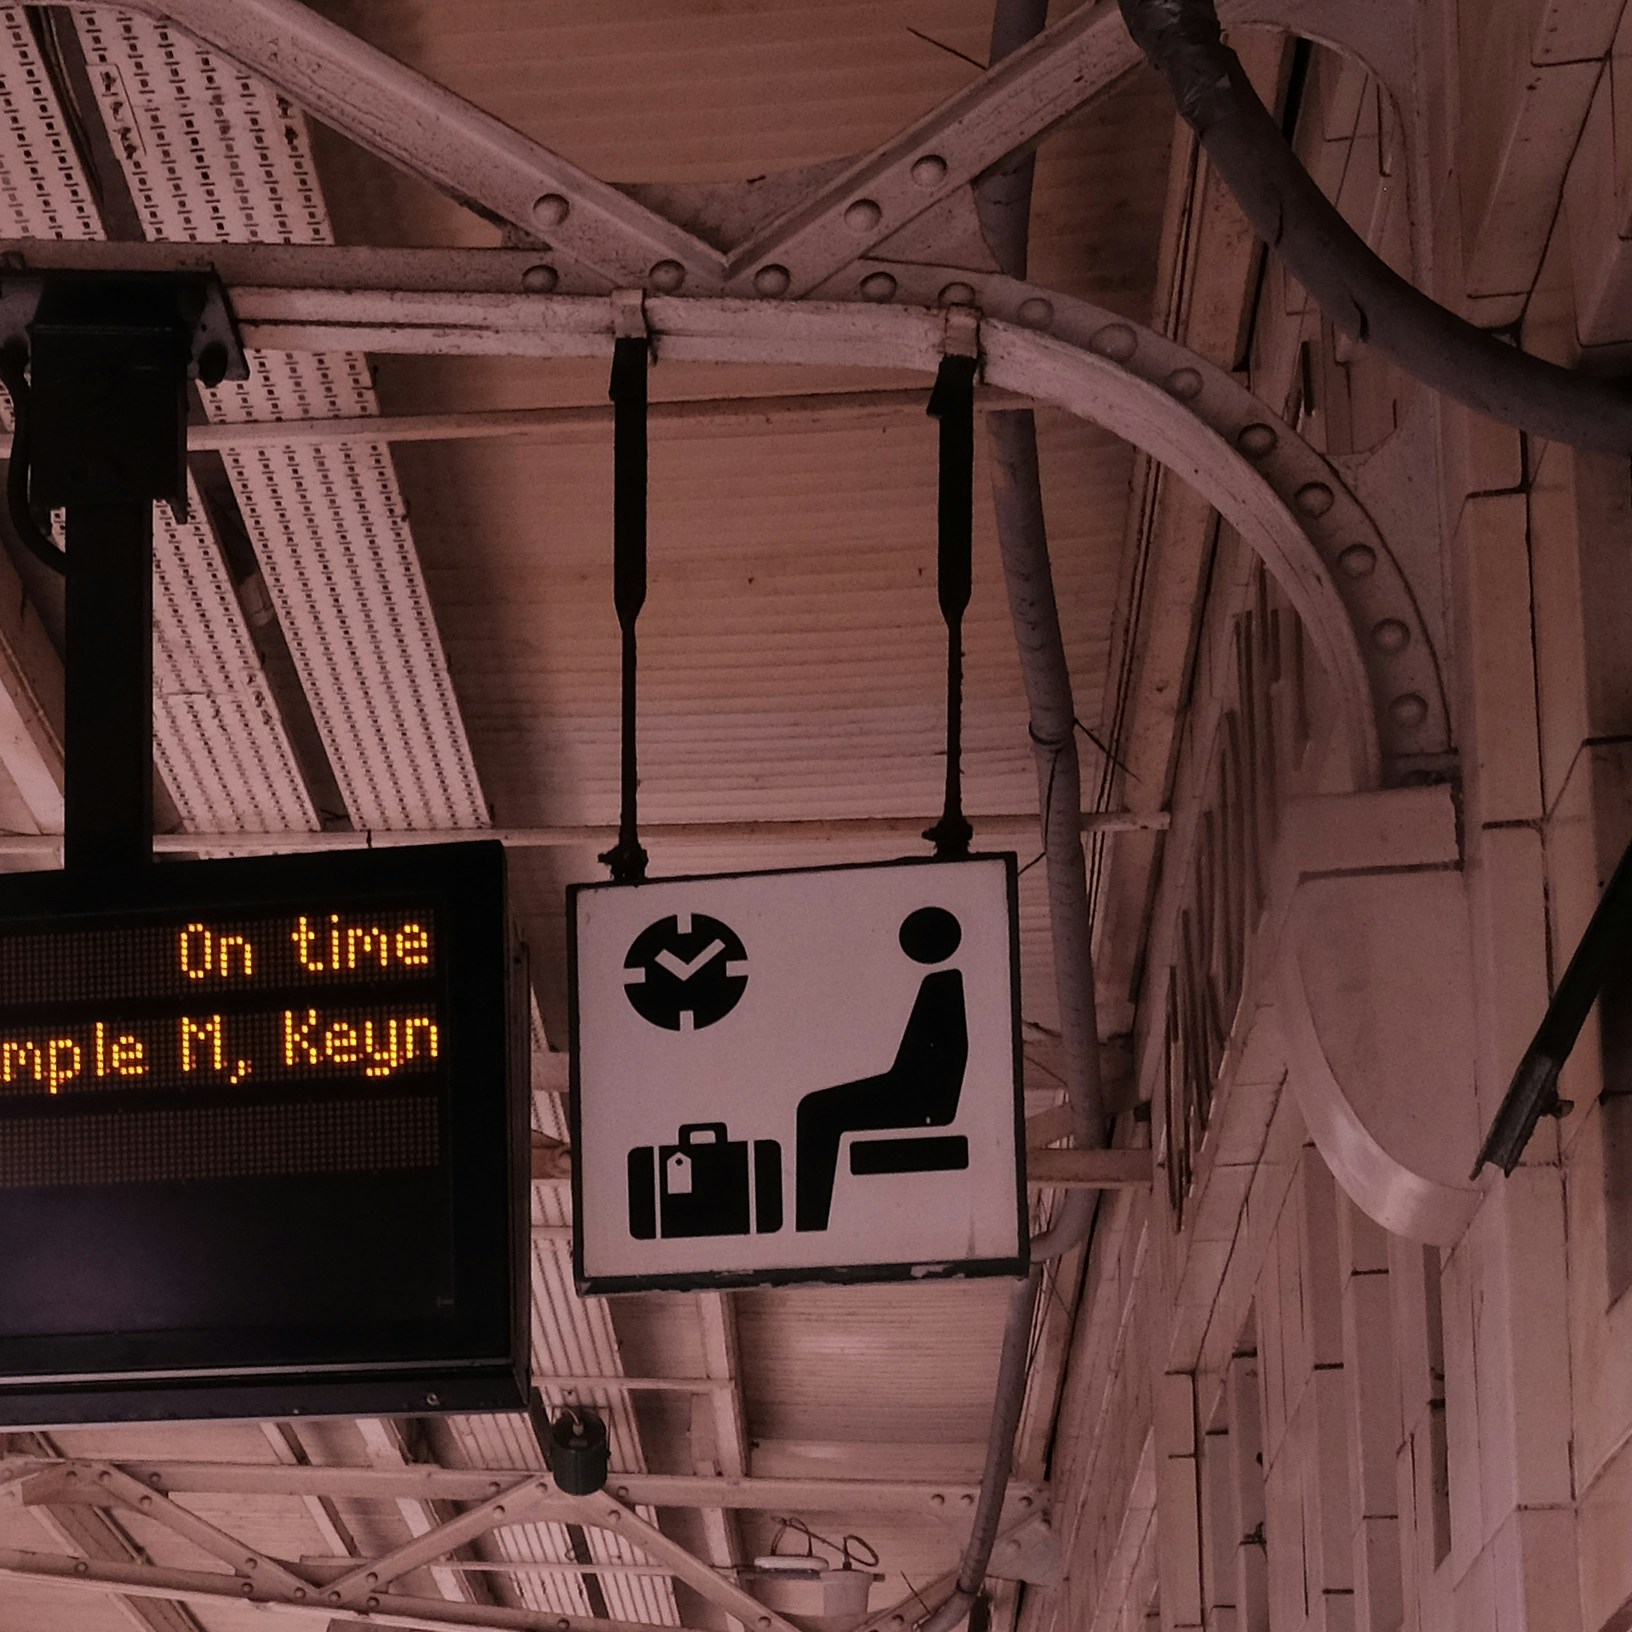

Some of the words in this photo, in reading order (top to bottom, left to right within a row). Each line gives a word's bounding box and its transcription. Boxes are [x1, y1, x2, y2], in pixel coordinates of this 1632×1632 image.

[180, 923, 252, 979] On
[291, 914, 429, 972] time
[181, 1014, 252, 1084] M,
[284, 1009, 438, 1077] Keyn
